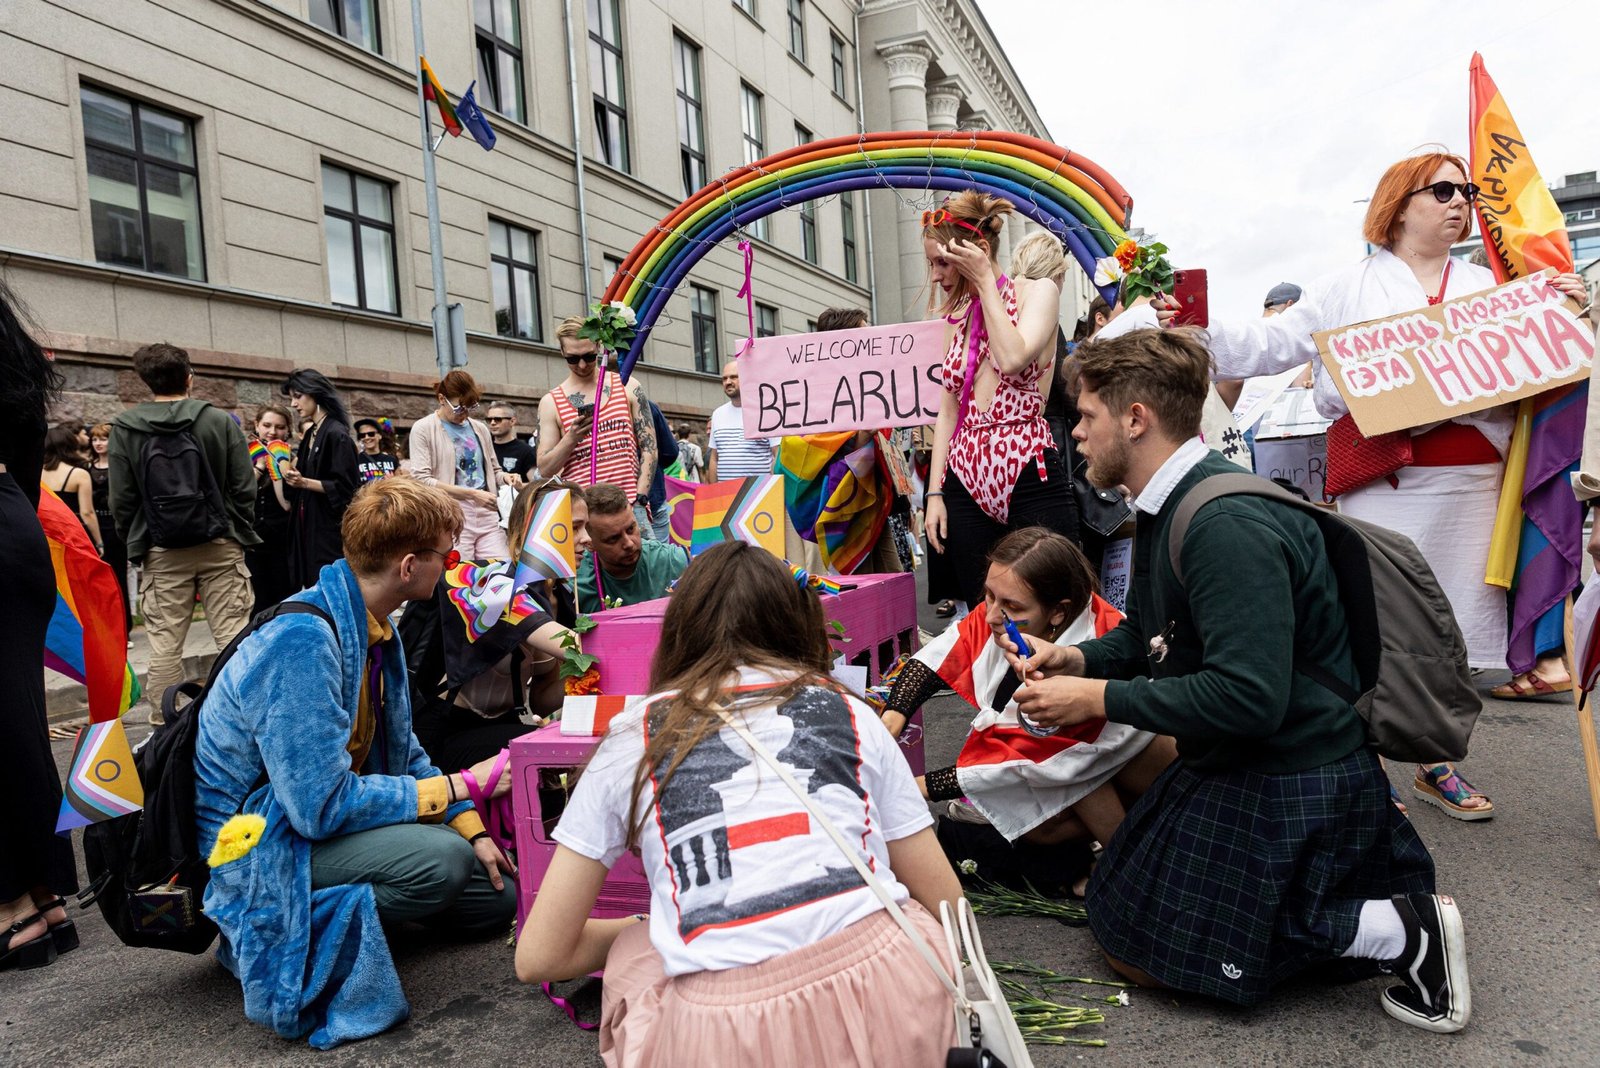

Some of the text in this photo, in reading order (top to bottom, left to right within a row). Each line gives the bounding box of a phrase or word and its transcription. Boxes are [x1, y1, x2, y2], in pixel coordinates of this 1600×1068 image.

[786, 333, 915, 365] WELCOME TO
[1332, 273, 1559, 360] КАХАЦЬ ЛЮДЗЕЙ
[1346, 308, 1595, 402] ГЭТА НОРМА
[758, 363, 944, 433] BELARUS
